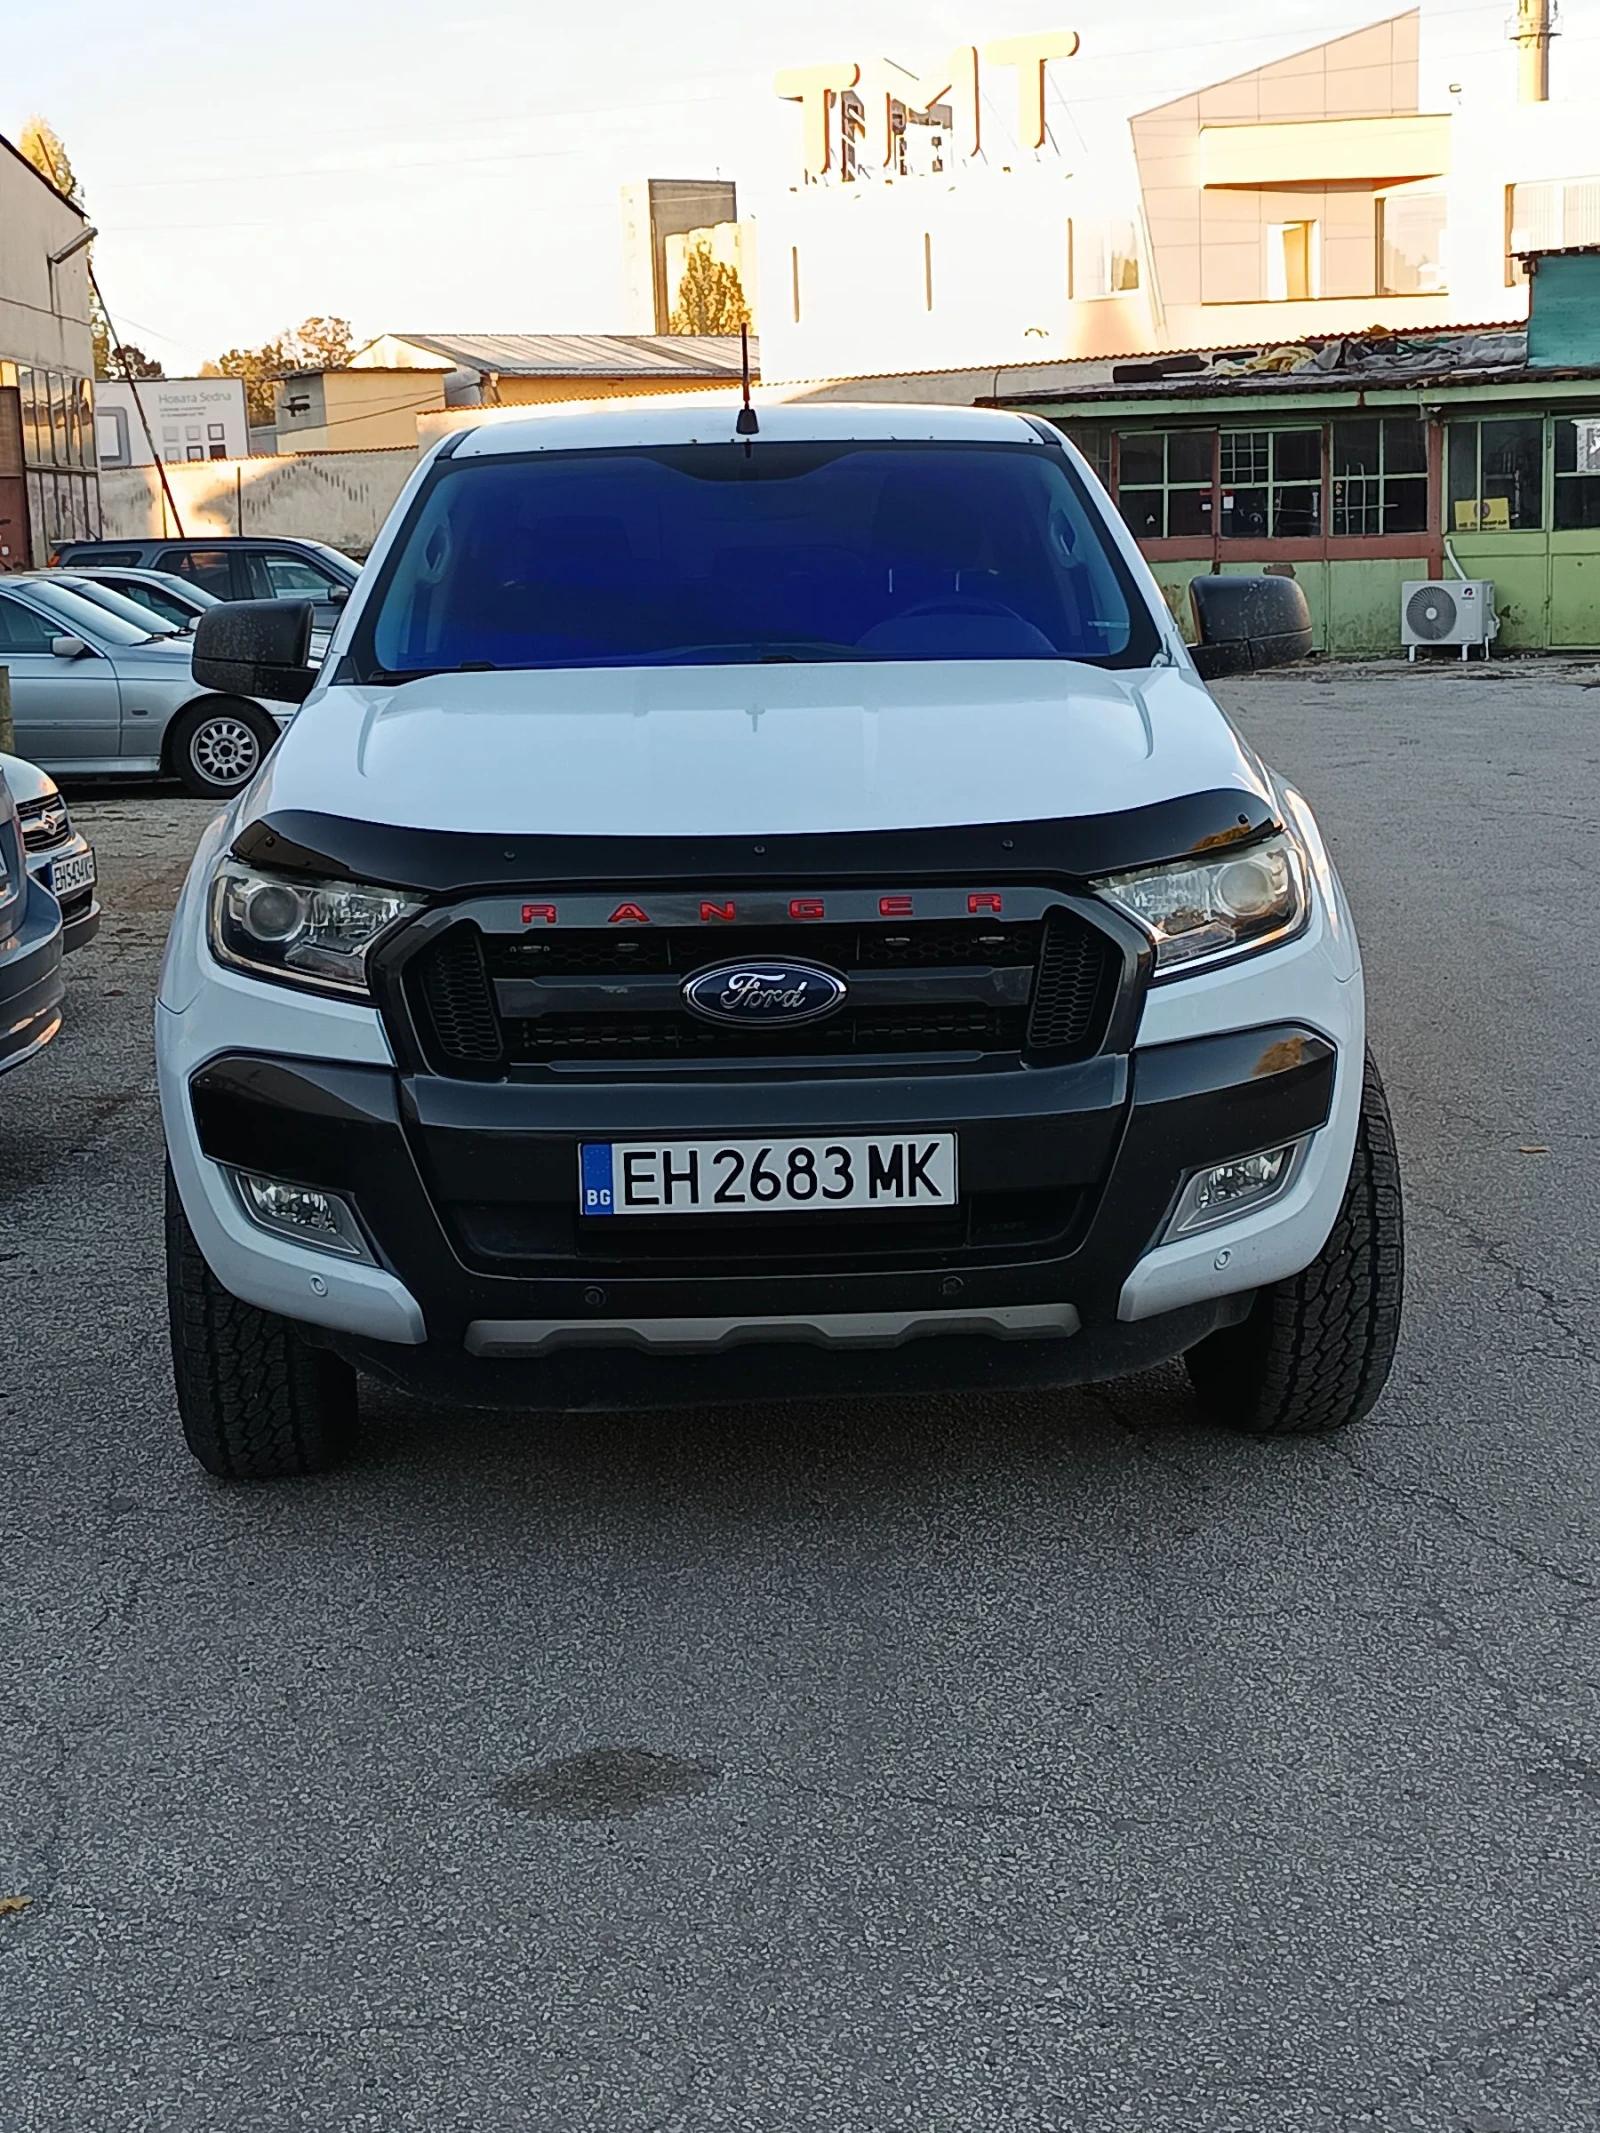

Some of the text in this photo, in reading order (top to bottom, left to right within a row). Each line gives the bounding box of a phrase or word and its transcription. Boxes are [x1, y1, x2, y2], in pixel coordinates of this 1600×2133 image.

[521, 893, 1003, 924] RANGER
[720, 972, 806, 1009] Ford
[587, 1189, 611, 1206] BG
